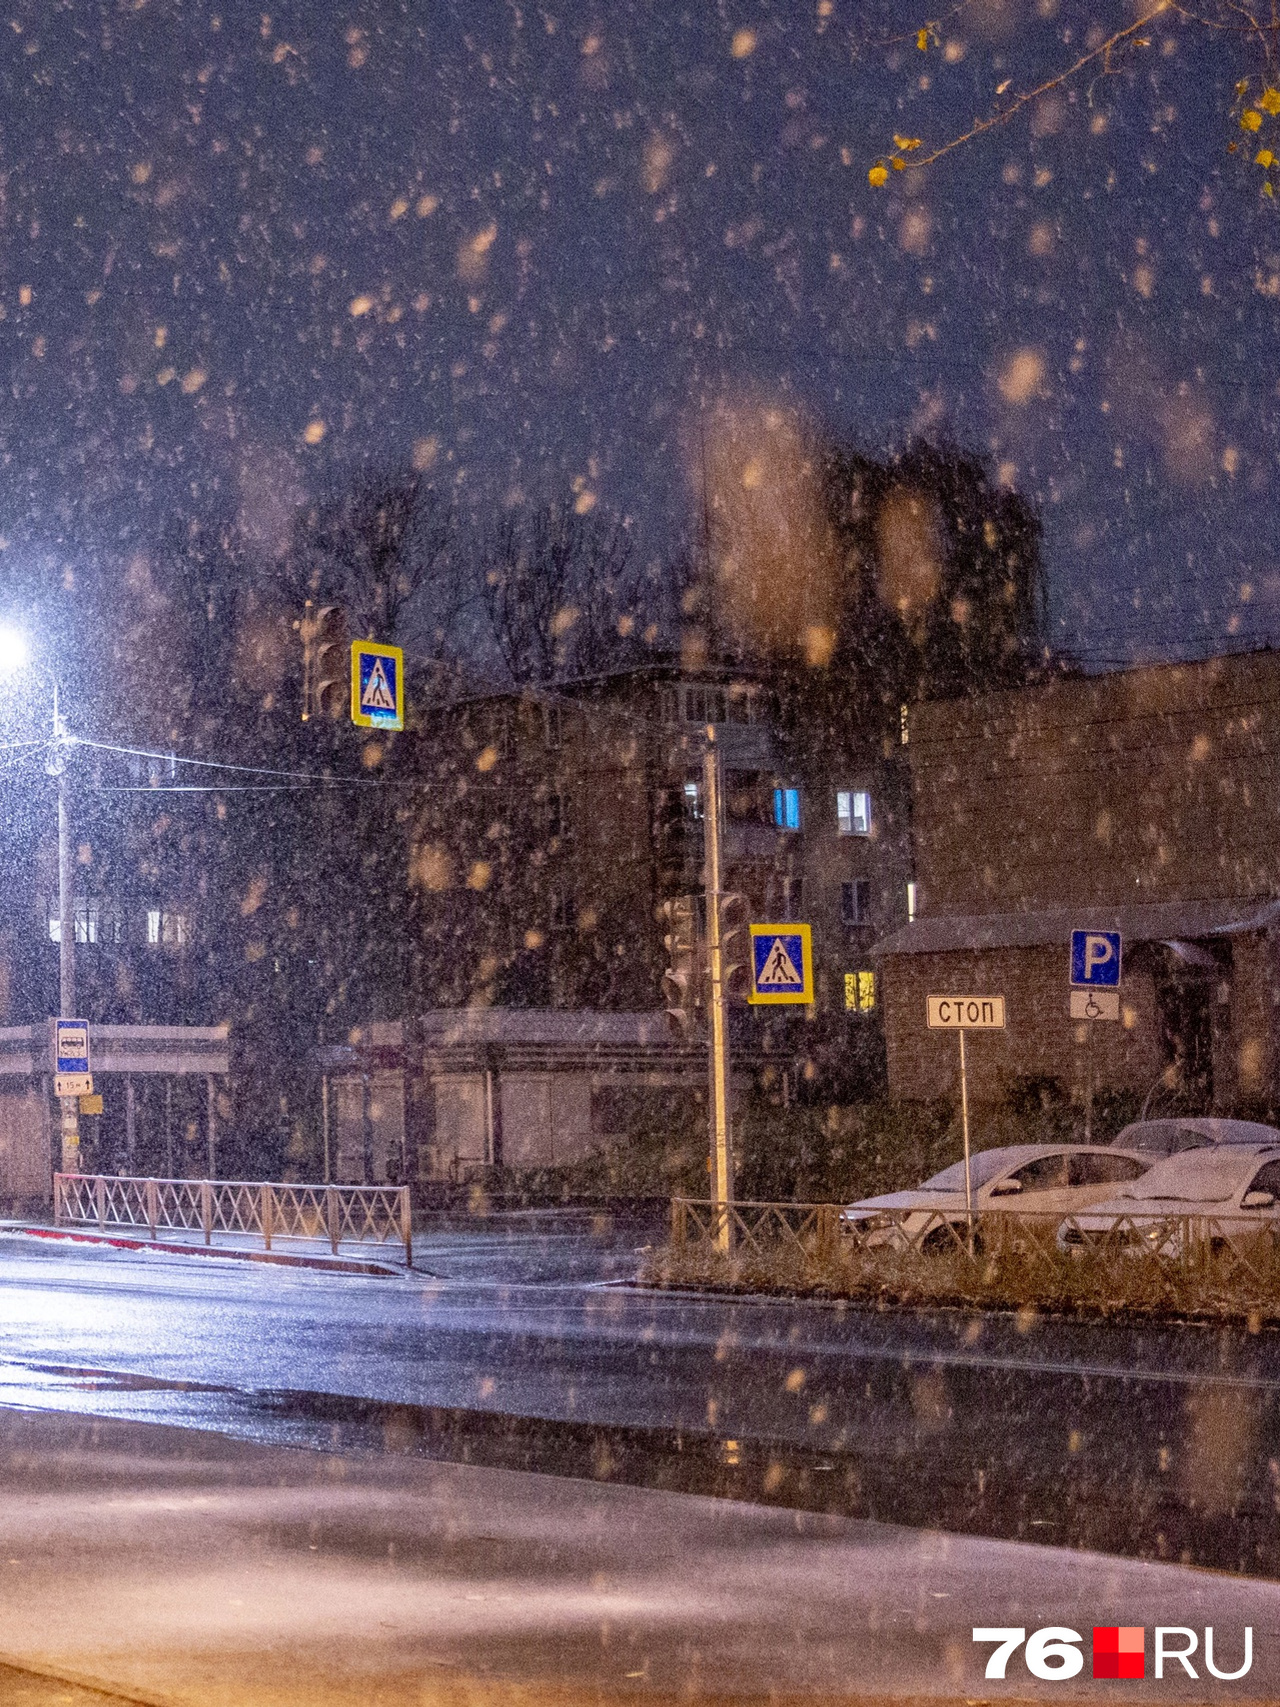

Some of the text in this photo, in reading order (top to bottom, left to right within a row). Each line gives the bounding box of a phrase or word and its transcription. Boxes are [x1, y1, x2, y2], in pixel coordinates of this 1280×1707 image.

[1084, 935, 1113, 979] P
[938, 1001, 994, 1023] СТОП
[65, 1081, 75, 1090] 15
